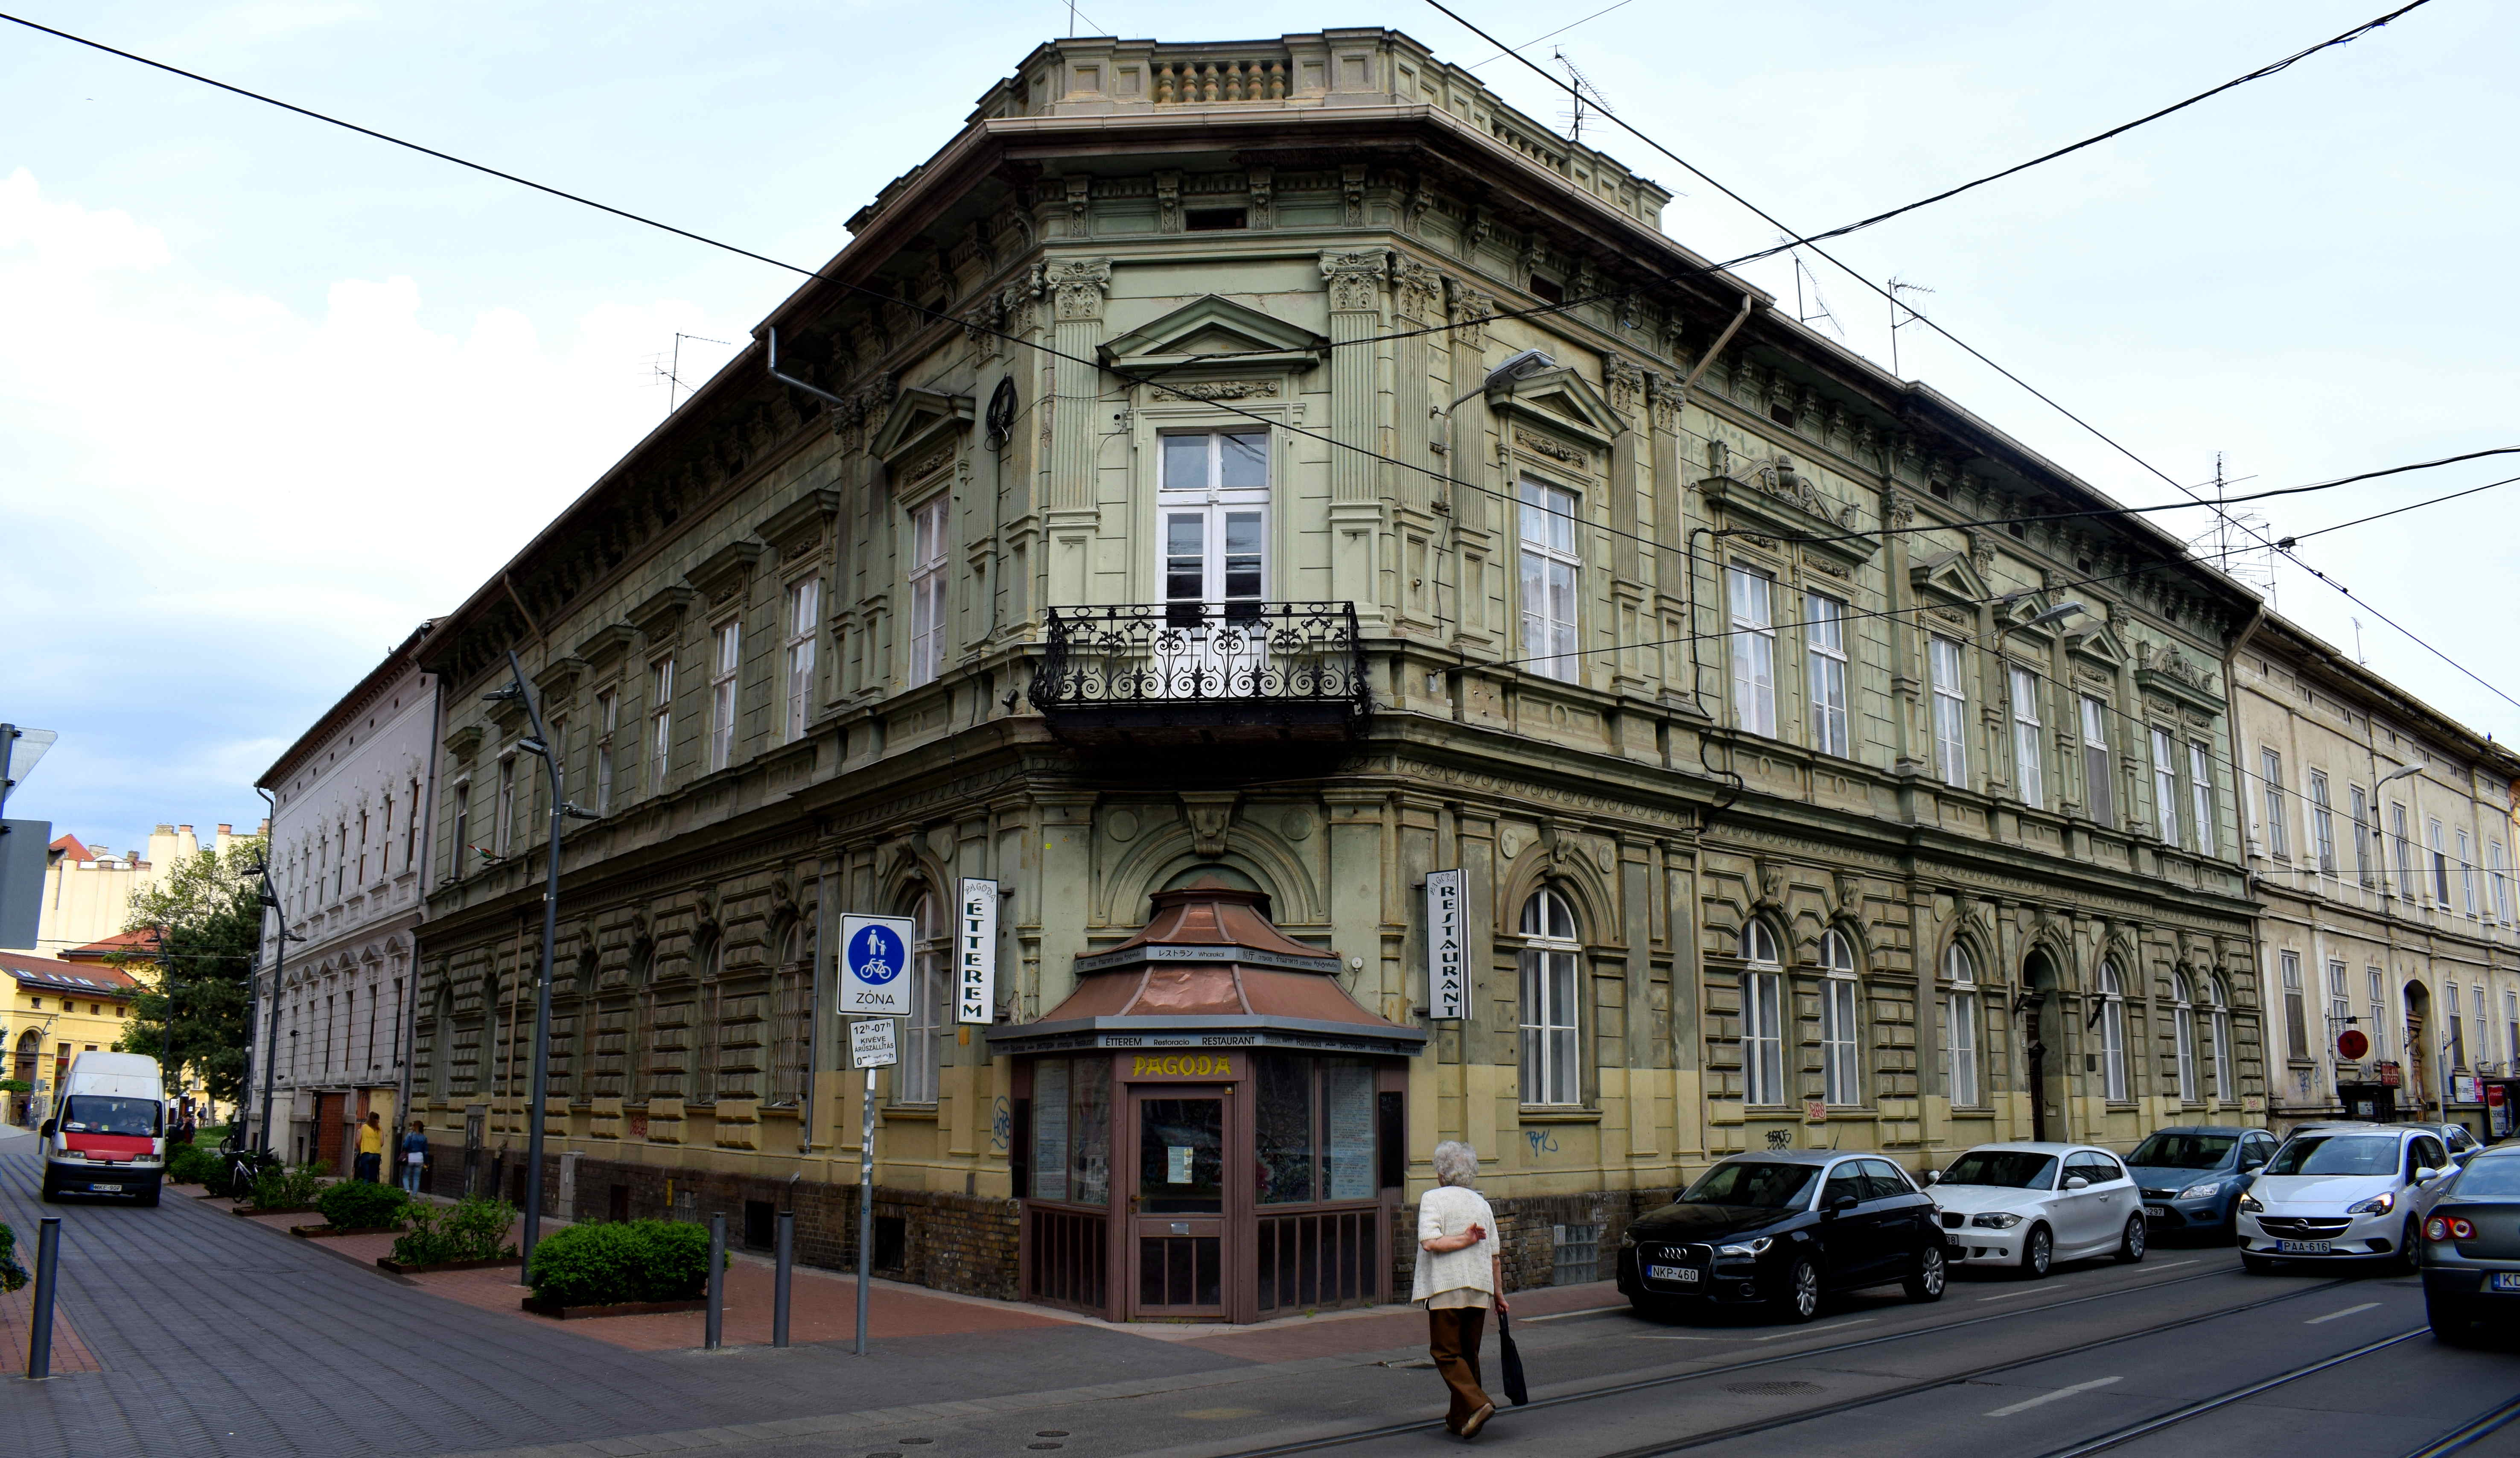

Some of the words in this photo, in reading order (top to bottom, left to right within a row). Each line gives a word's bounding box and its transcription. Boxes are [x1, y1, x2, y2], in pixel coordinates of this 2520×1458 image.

[965, 883, 996, 902] PAGODA
[963, 898, 984, 1018] ÉTTEREM
[1440, 886, 1459, 1016] RESTAURANT
[856, 990, 895, 1005] ZÓNA
[860, 1036, 887, 1044] KIVÉVE
[1106, 1035, 1142, 1046] ÉTTEREM
[1202, 1036, 1255, 1045] RESTAURANT
[1132, 1053, 1232, 1077] PAGODA
[2284, 1242, 2328, 1251] PAA-616
[1653, 1266, 1696, 1280] NKP-460
